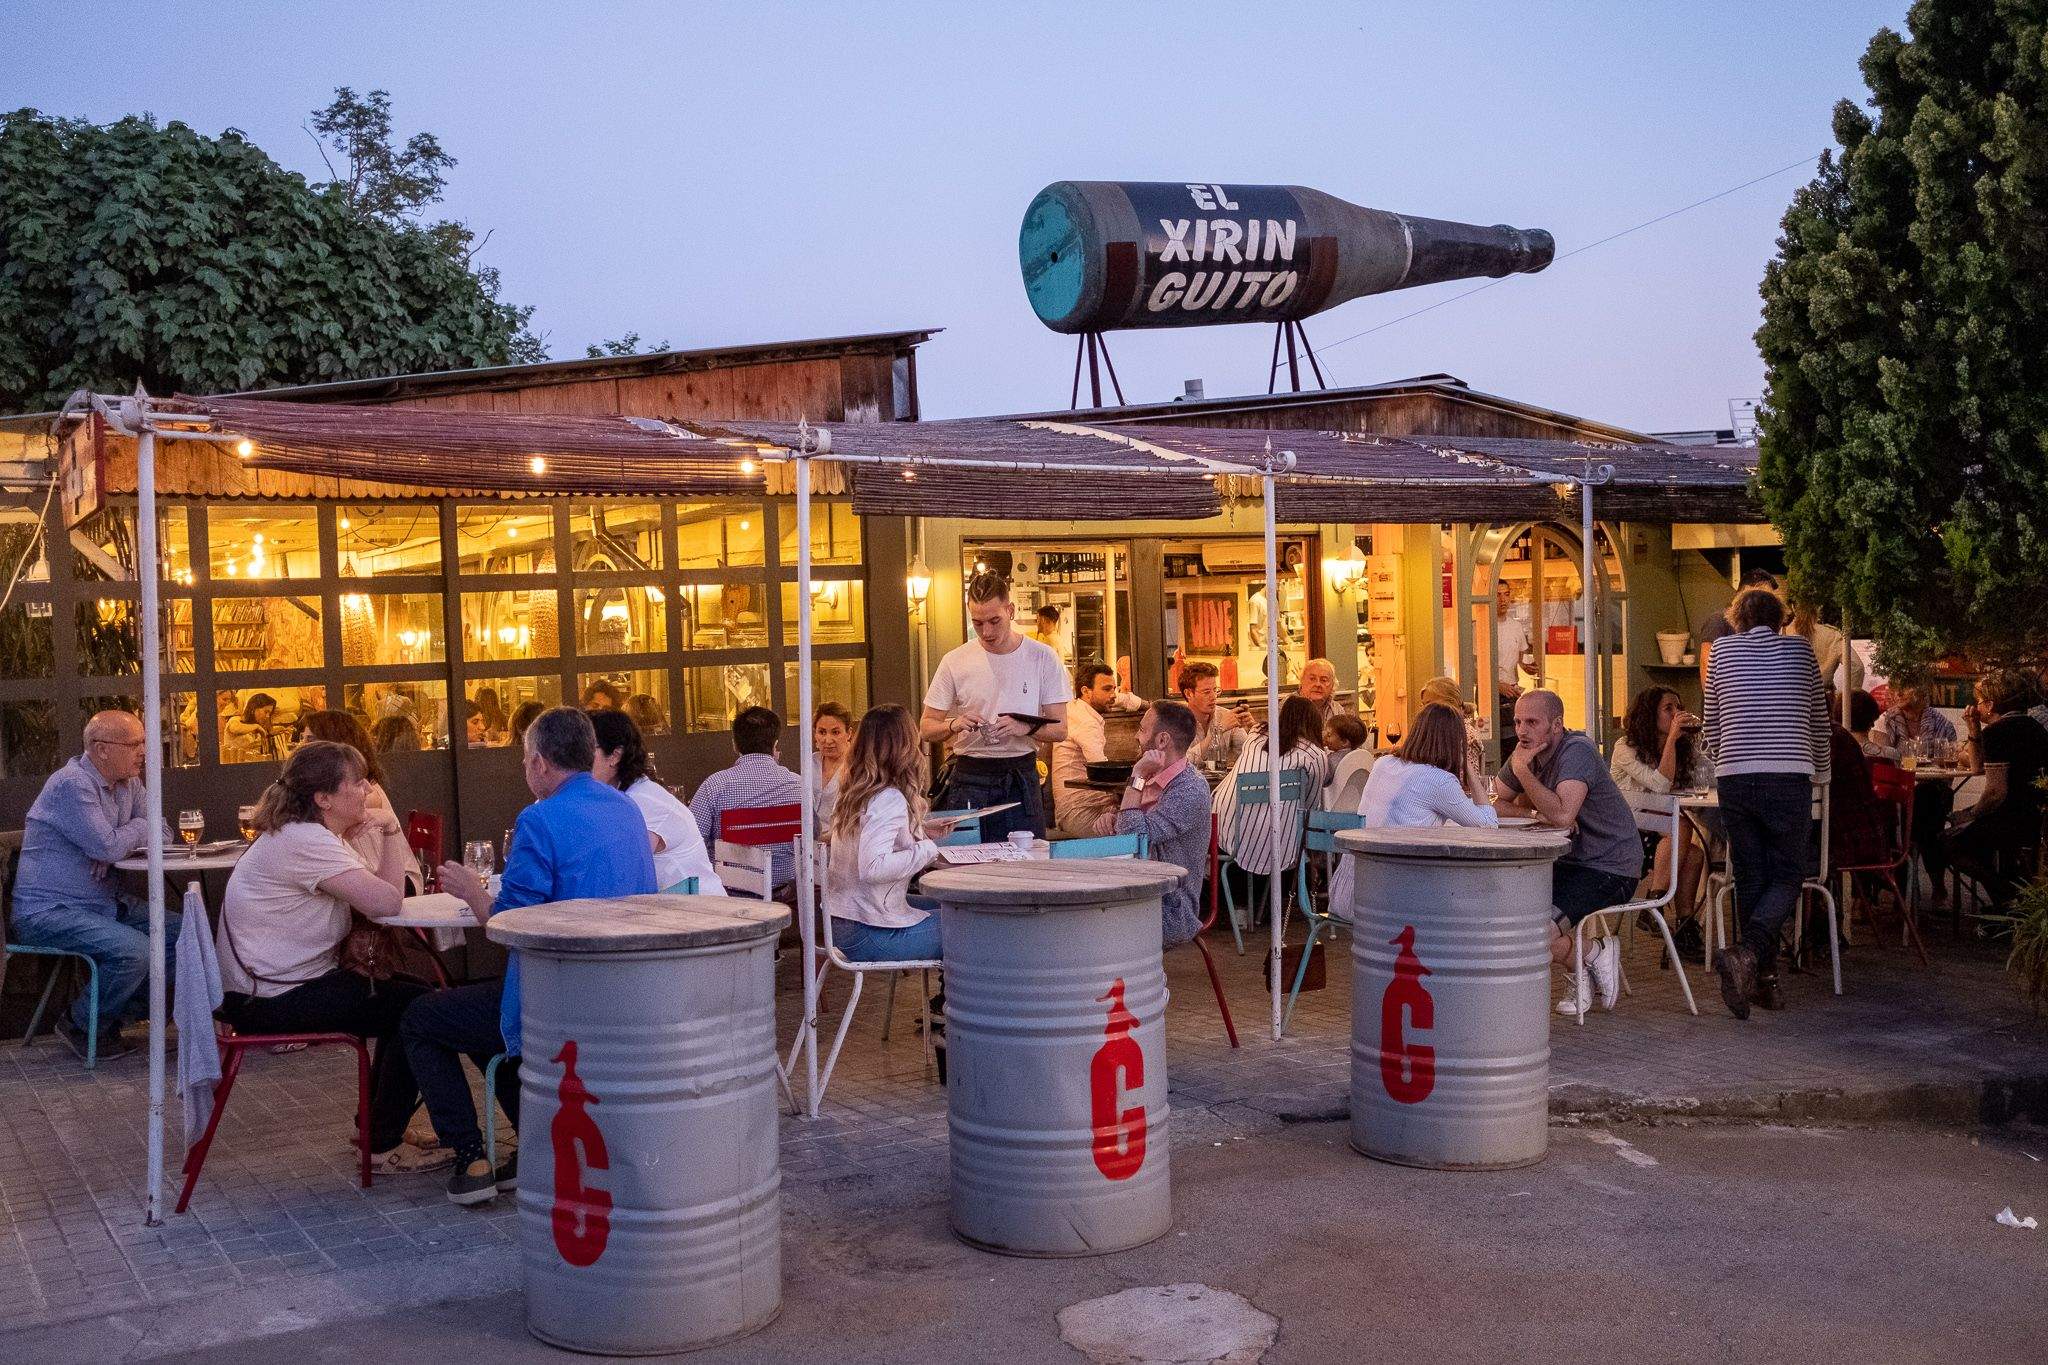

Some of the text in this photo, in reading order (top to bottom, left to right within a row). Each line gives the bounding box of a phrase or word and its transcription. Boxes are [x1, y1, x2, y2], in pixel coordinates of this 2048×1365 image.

[1186, 184, 1239, 211] EL
[1159, 218, 1297, 265] XIRIN
[1147, 270, 1298, 312] GUITO
[1188, 599, 1233, 648] WINE
